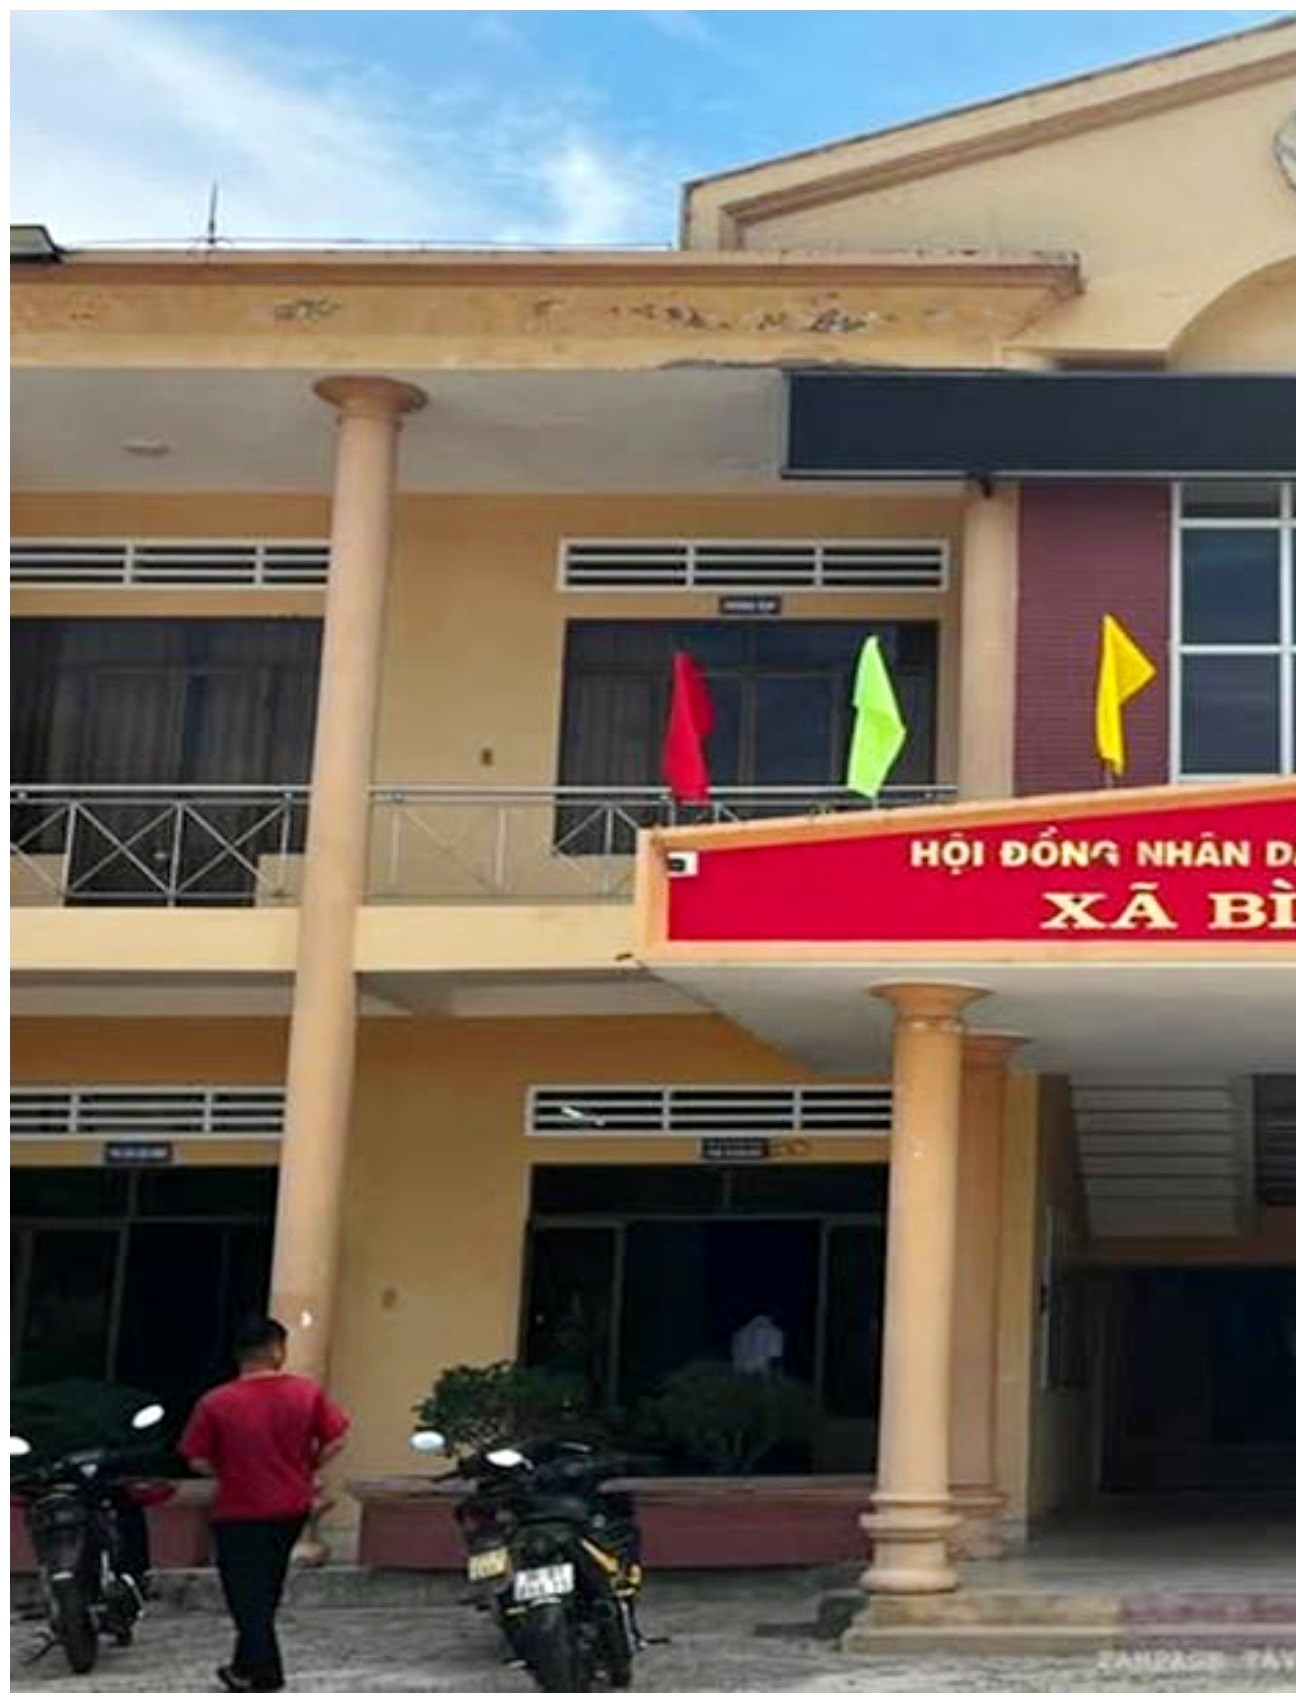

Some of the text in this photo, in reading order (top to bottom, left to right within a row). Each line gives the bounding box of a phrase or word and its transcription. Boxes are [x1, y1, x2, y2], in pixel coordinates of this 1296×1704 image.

[911, 833, 985, 875] HỘI
[1137, 831, 1251, 868] NHÂN
[1040, 882, 1178, 930] XÃ
